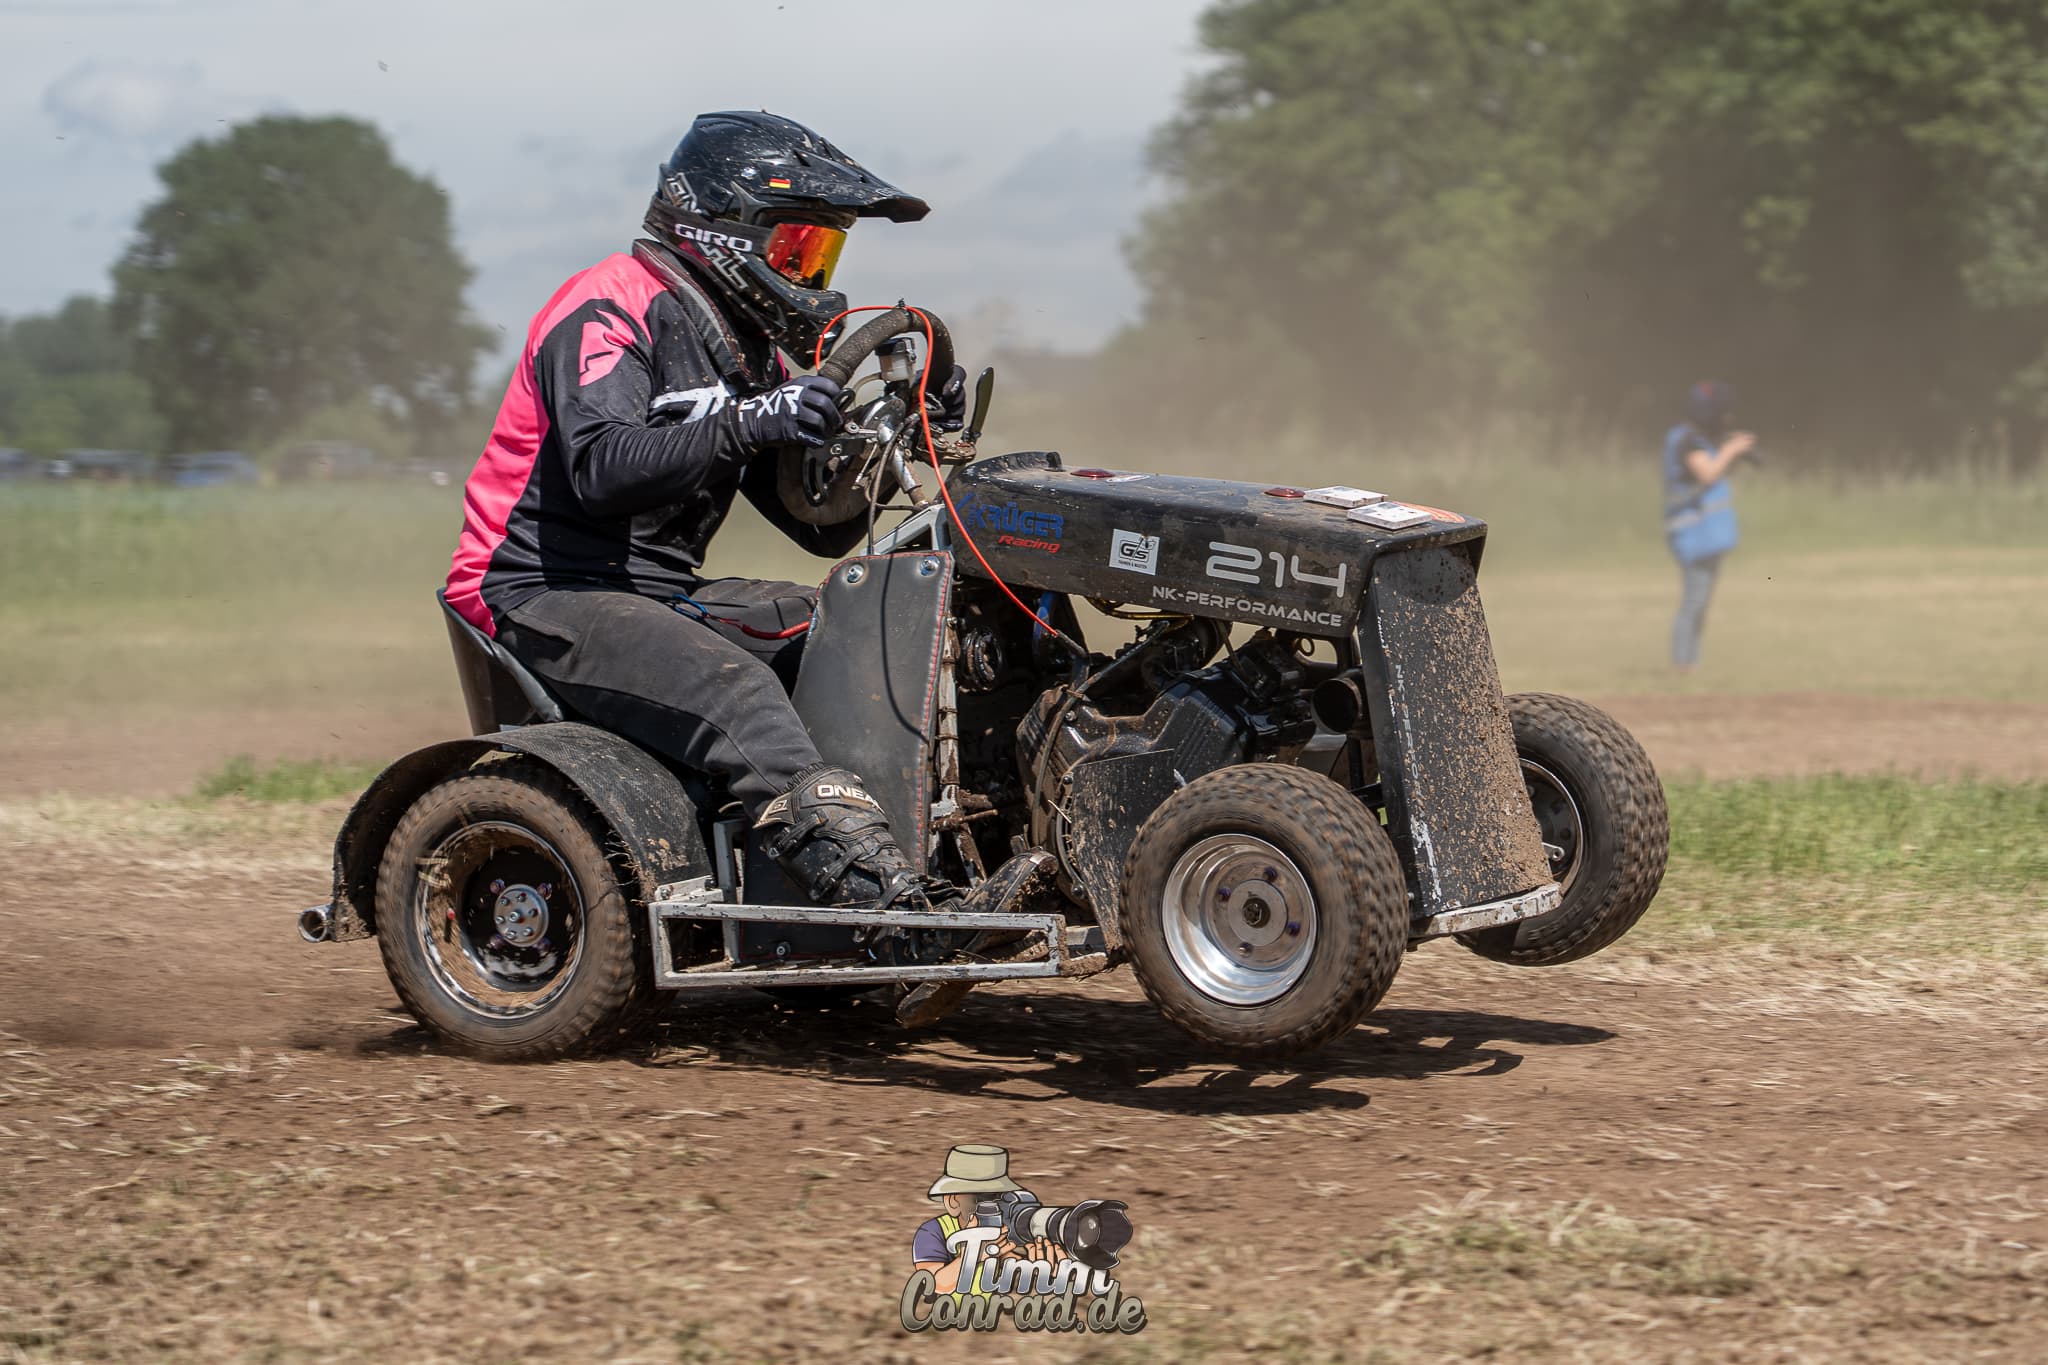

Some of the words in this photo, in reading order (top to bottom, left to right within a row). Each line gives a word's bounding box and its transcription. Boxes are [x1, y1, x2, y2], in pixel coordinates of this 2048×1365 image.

[675, 223, 753, 252] GIRO
[739, 385, 804, 422] FXR
[998, 535, 1060, 553] Racing
[1206, 541, 1347, 598] 214
[1153, 586, 1342, 627] NK-PERFORMANCE
